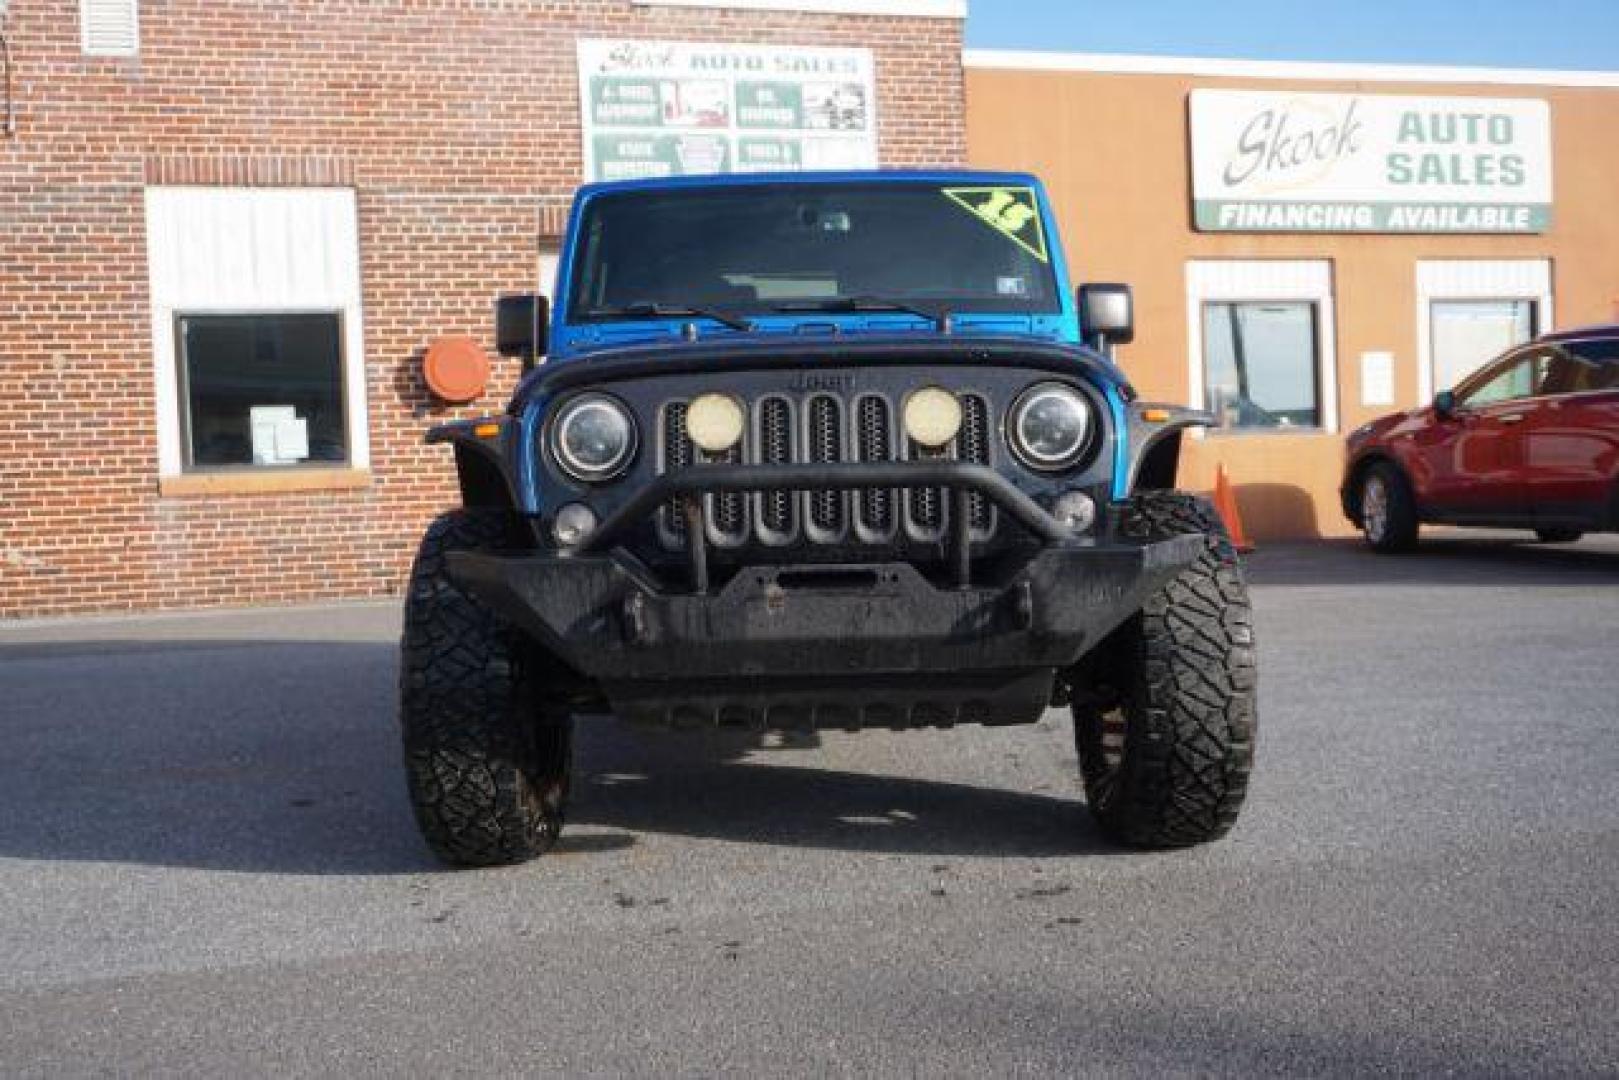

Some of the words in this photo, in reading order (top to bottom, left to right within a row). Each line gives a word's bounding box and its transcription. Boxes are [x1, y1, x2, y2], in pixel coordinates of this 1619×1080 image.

[1222, 99, 1362, 187] Skook
[1396, 111, 1514, 145] AUTO
[1385, 153, 1526, 187] SALES
[1218, 203, 1375, 229] FINANCING
[1387, 205, 1531, 229] AVAILABLE
